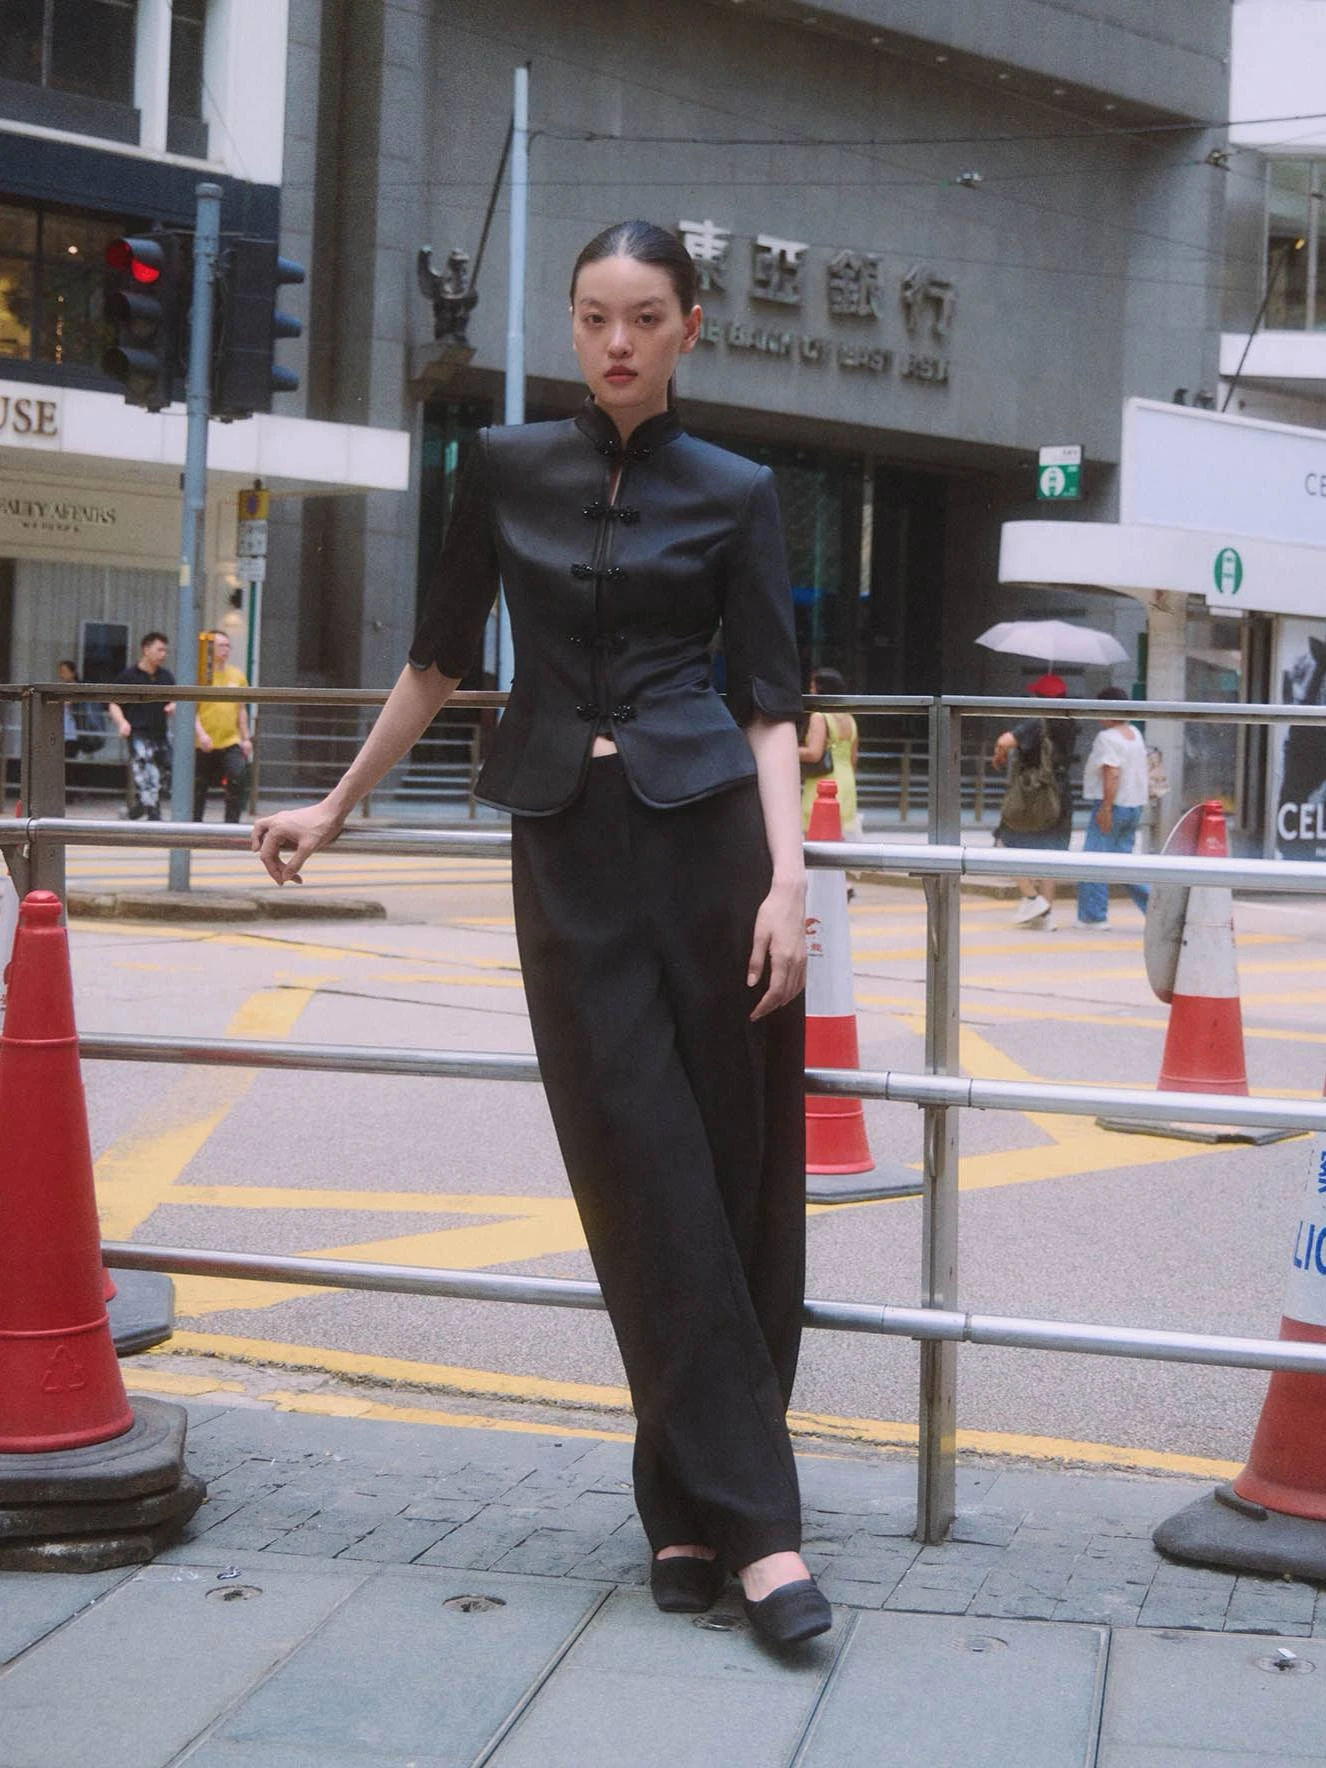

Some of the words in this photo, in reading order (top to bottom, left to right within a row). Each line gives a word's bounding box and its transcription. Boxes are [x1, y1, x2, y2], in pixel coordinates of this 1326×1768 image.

[678, 220, 954, 342] 東亞銀行
[1278, 802, 1326, 841] CEL
